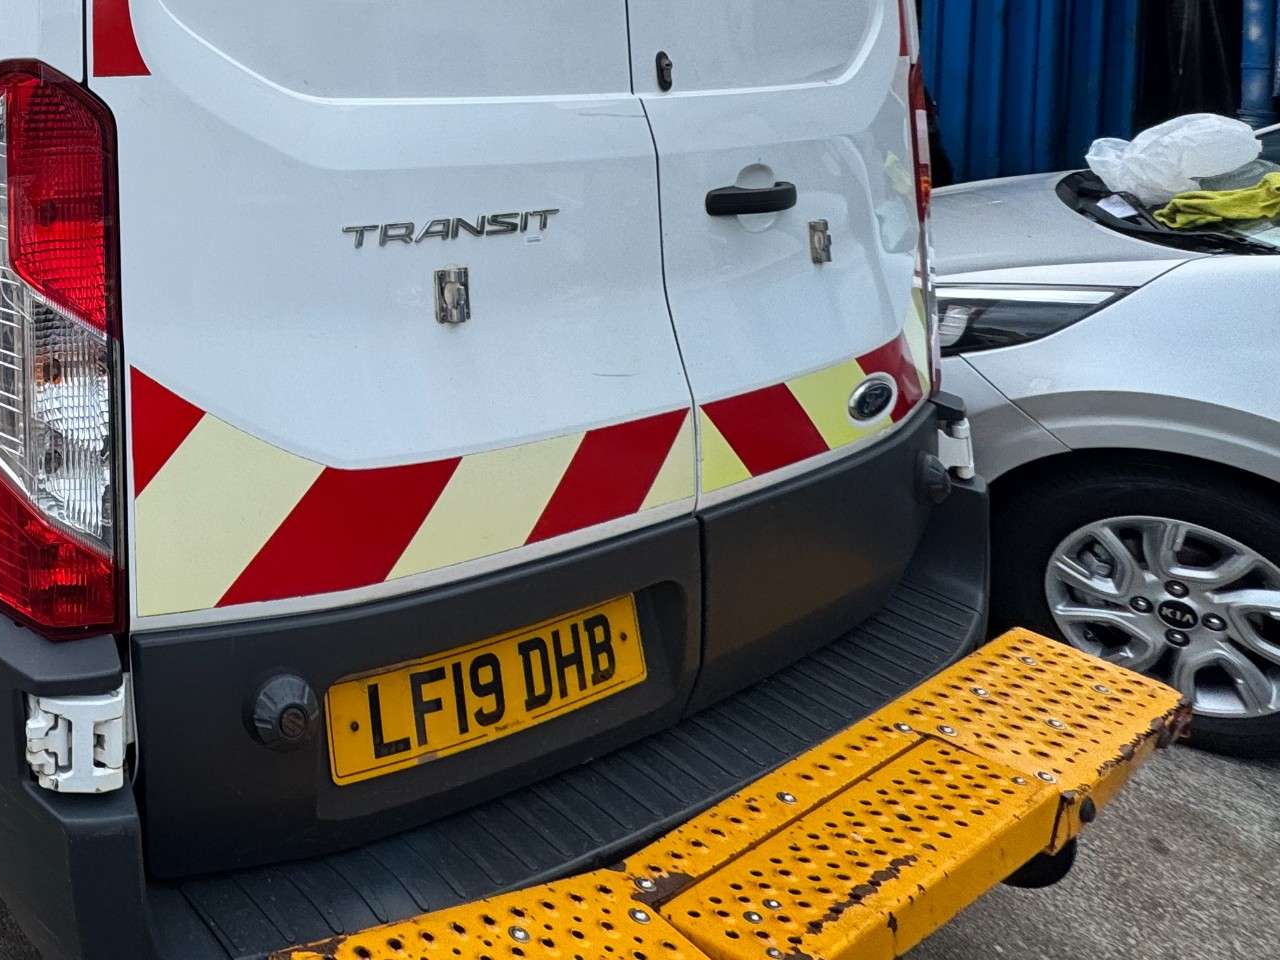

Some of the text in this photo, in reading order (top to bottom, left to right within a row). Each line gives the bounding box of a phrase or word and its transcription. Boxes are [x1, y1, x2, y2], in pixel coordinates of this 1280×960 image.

[342, 208, 560, 249] TRANSIT
[1161, 606, 1195, 625] KIA
[367, 613, 616, 759] LF19 DHB
